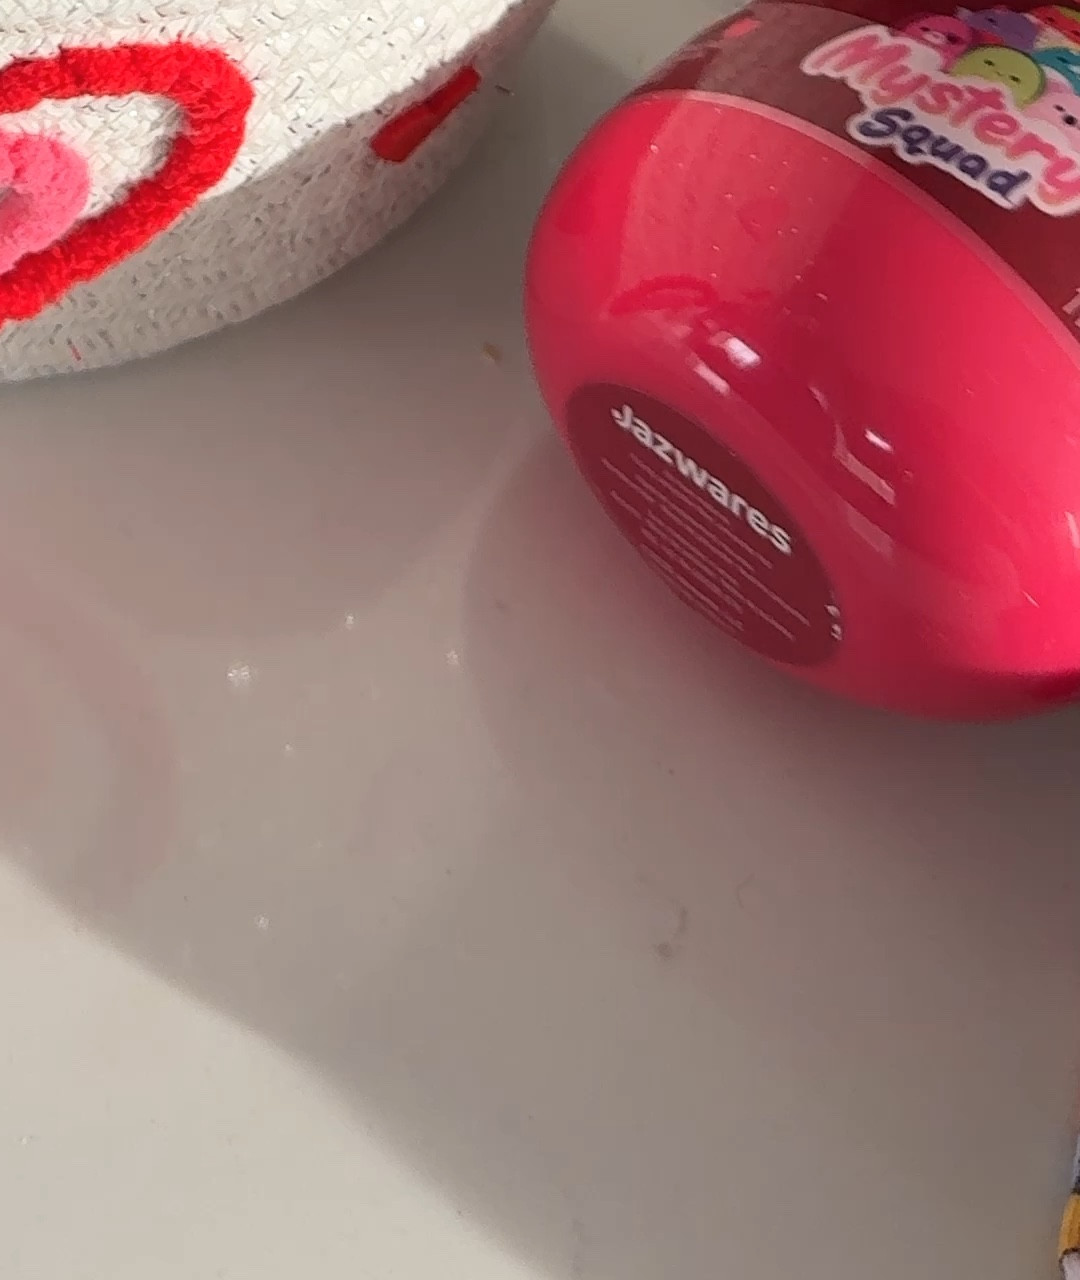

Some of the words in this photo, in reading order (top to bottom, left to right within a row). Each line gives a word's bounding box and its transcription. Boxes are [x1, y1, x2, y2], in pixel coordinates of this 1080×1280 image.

[812, 31, 1080, 206] Mystery
[855, 106, 1032, 201] Squad
[609, 403, 792, 556] Jazwares
